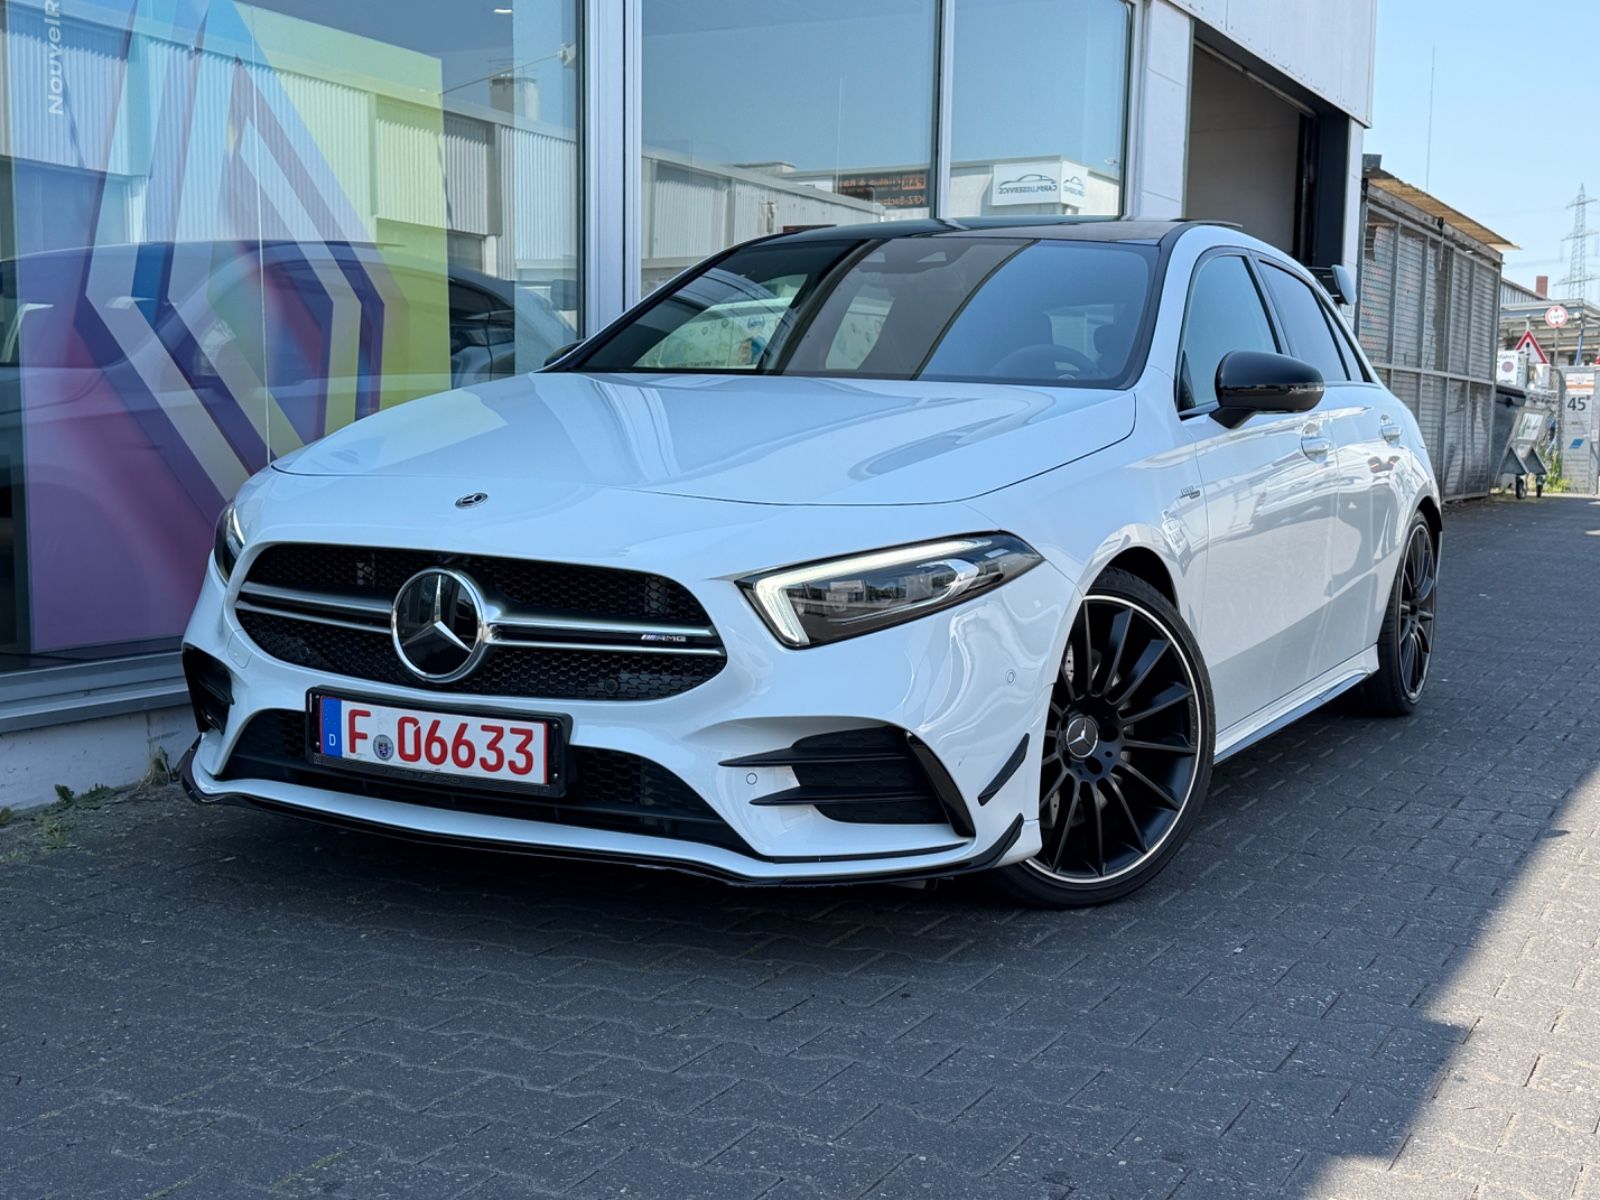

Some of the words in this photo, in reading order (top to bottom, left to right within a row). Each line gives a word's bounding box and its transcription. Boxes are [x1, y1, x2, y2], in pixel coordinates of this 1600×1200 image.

[1567, 396, 1587, 411] 45
[328, 733, 336, 746] D
[348, 708, 372, 754] F
[397, 715, 534, 776] 06633
